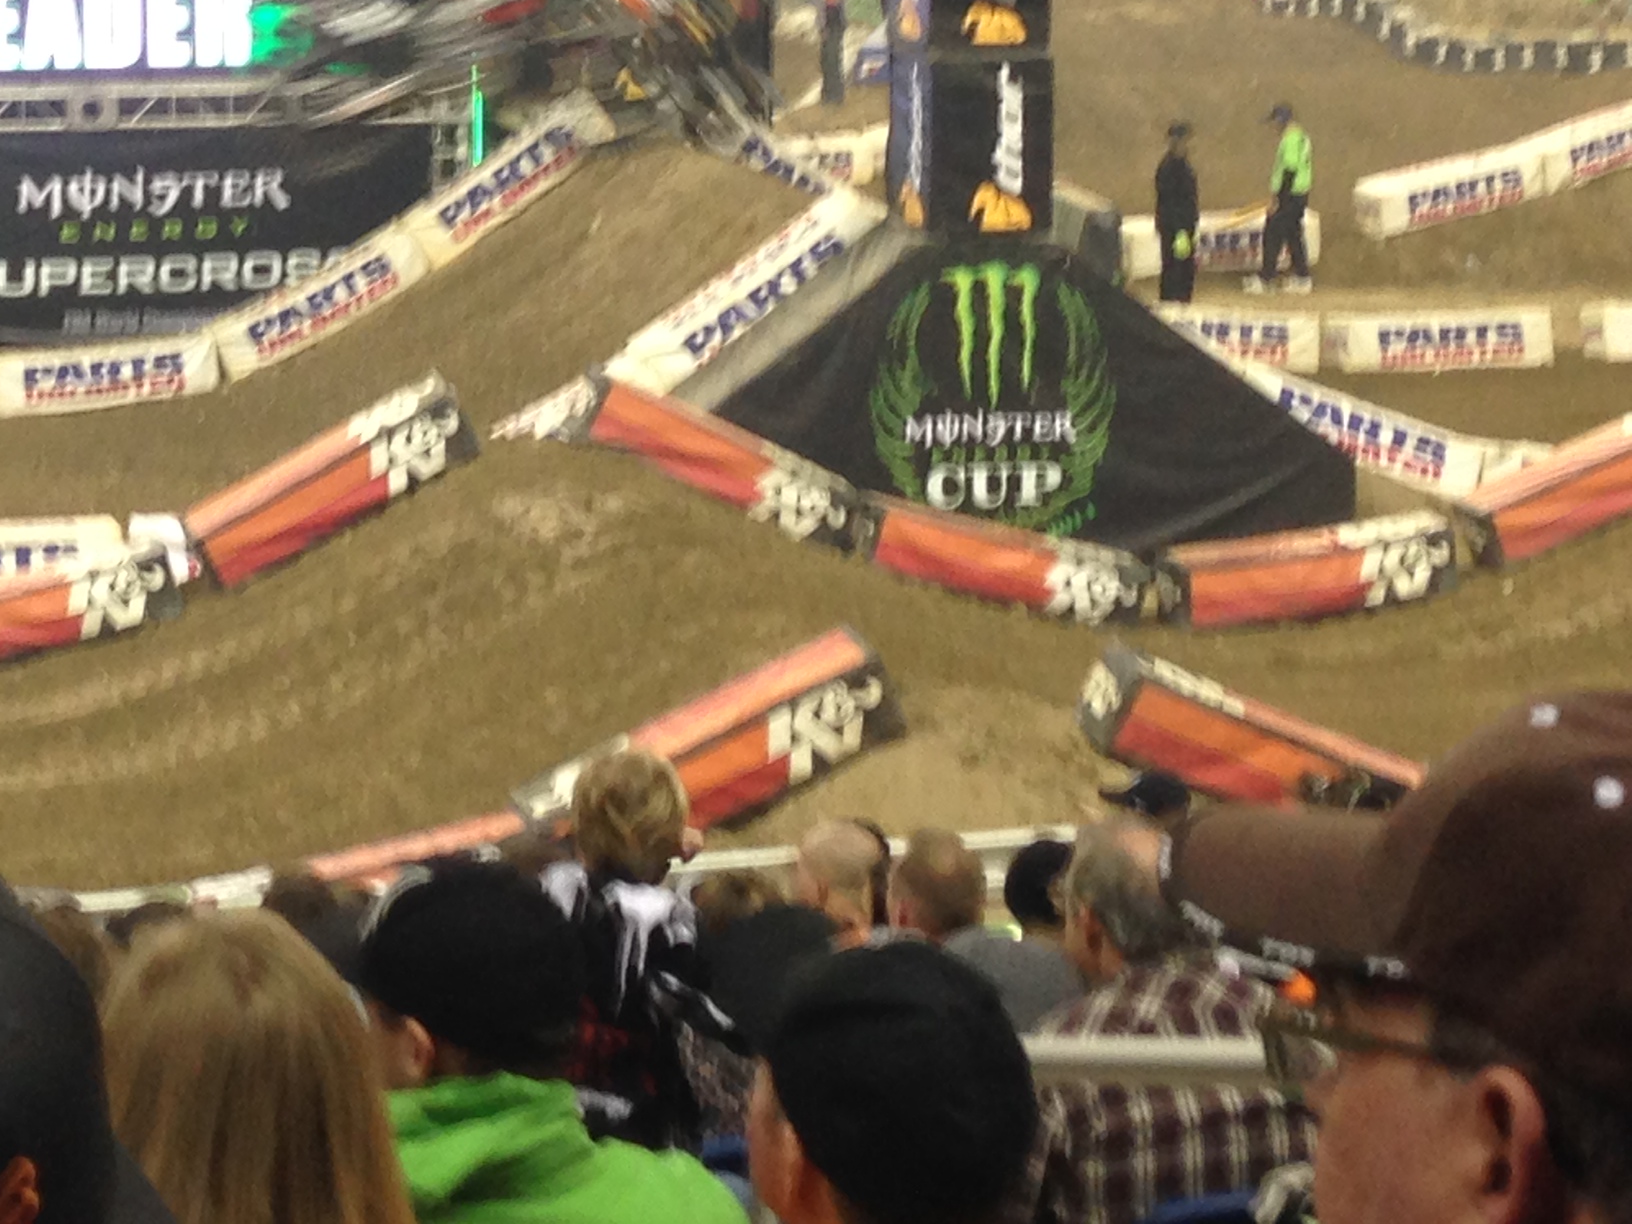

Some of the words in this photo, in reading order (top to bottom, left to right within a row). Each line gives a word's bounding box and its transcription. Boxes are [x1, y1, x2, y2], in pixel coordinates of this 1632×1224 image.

[15, 165, 292, 220] MONSTER
[904, 406, 1077, 451] MONSTER
[925, 459, 1063, 511] CUP
